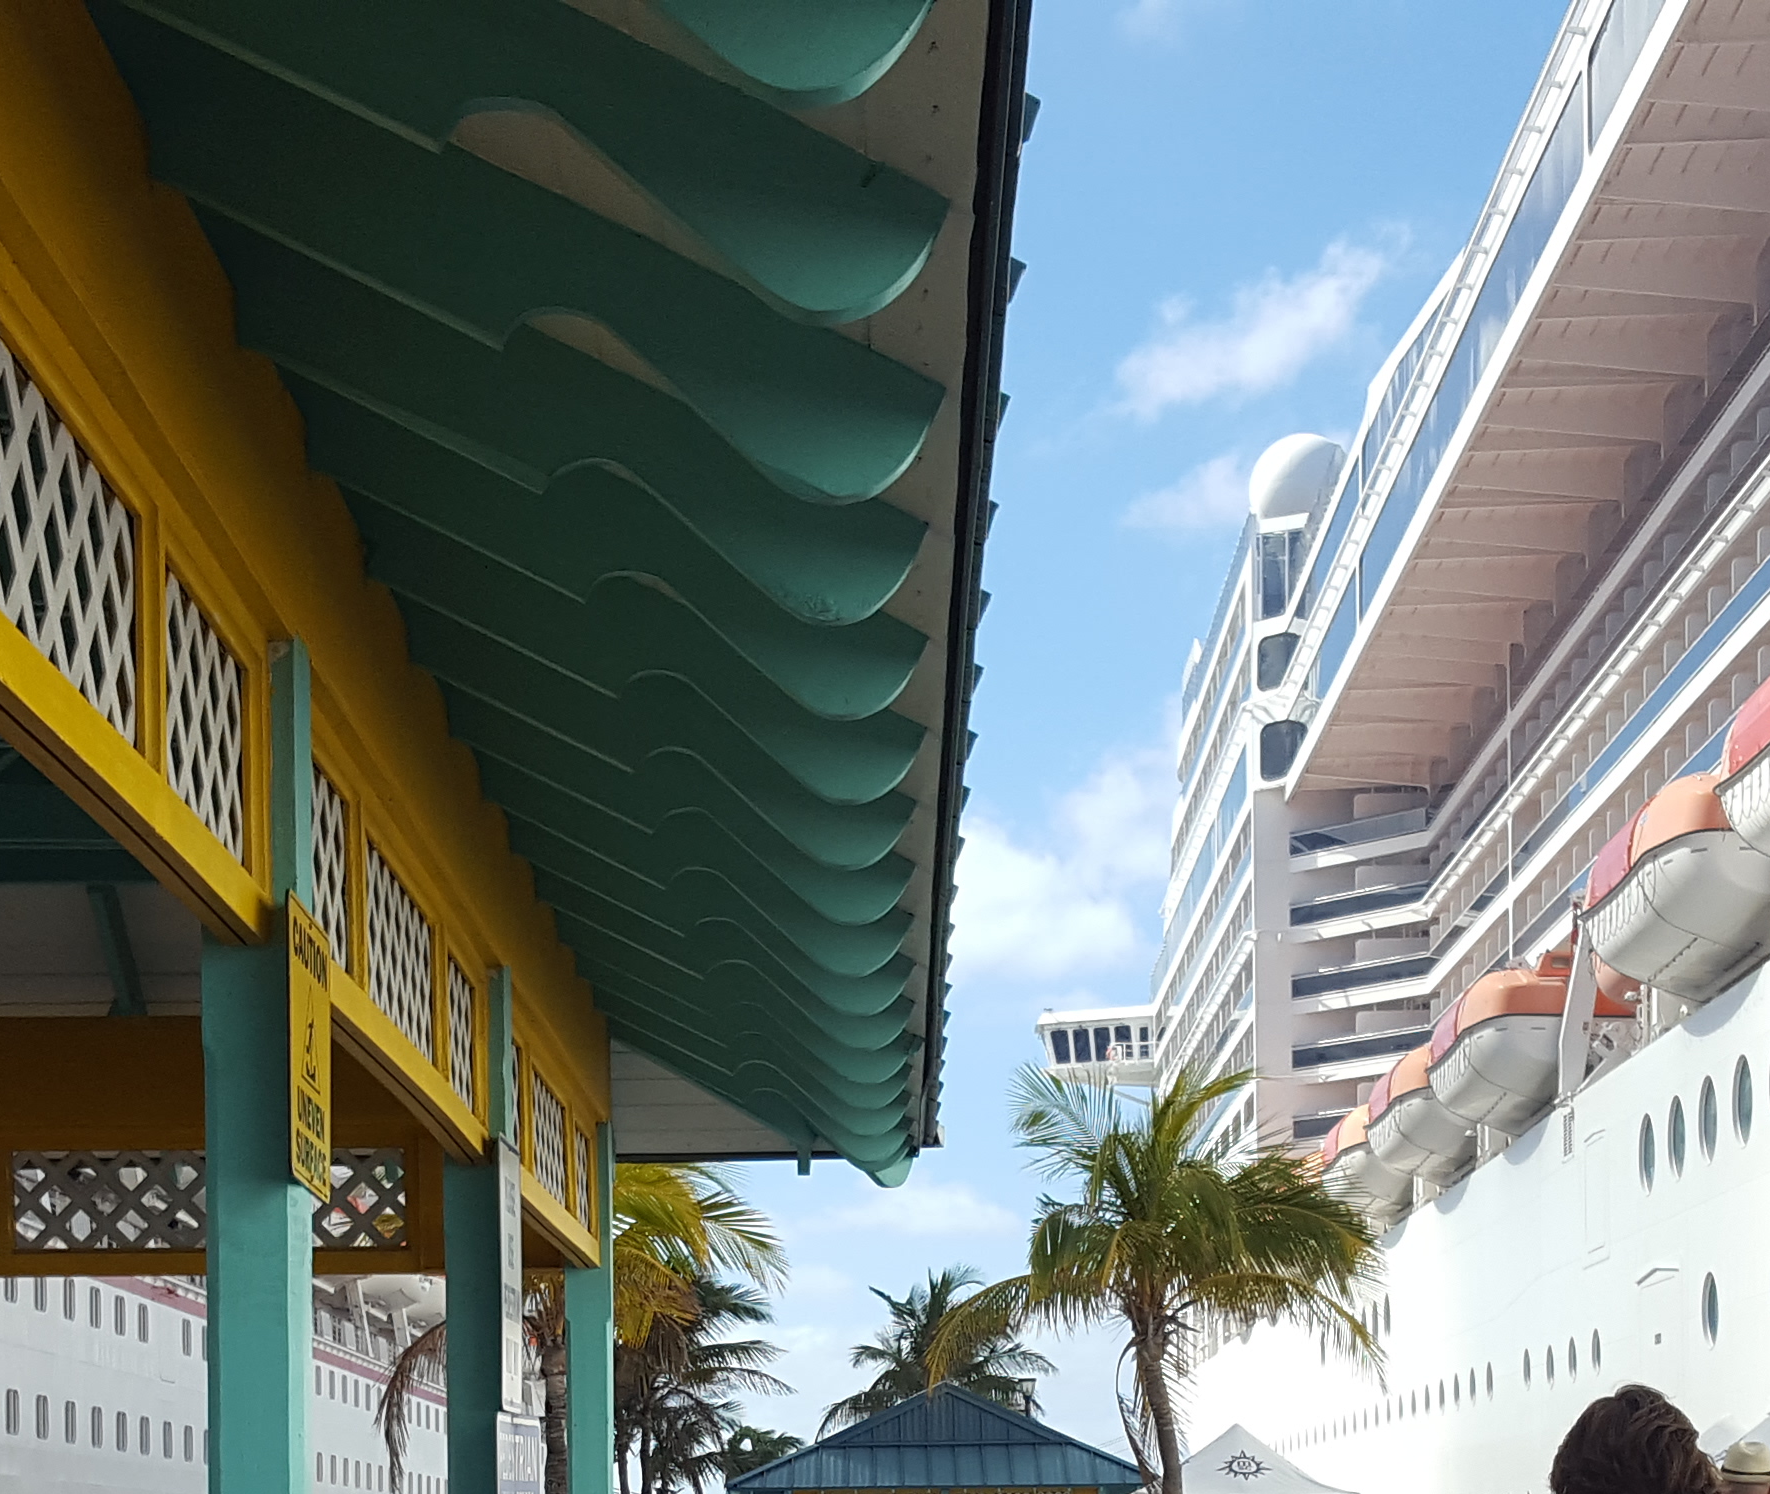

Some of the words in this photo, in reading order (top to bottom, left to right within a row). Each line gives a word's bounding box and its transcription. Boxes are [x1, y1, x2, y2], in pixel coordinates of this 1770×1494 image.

[293, 915, 328, 992] CAUTION
[297, 1084, 325, 1145] UNEVEN
[295, 1128, 327, 1188] SURFACE
